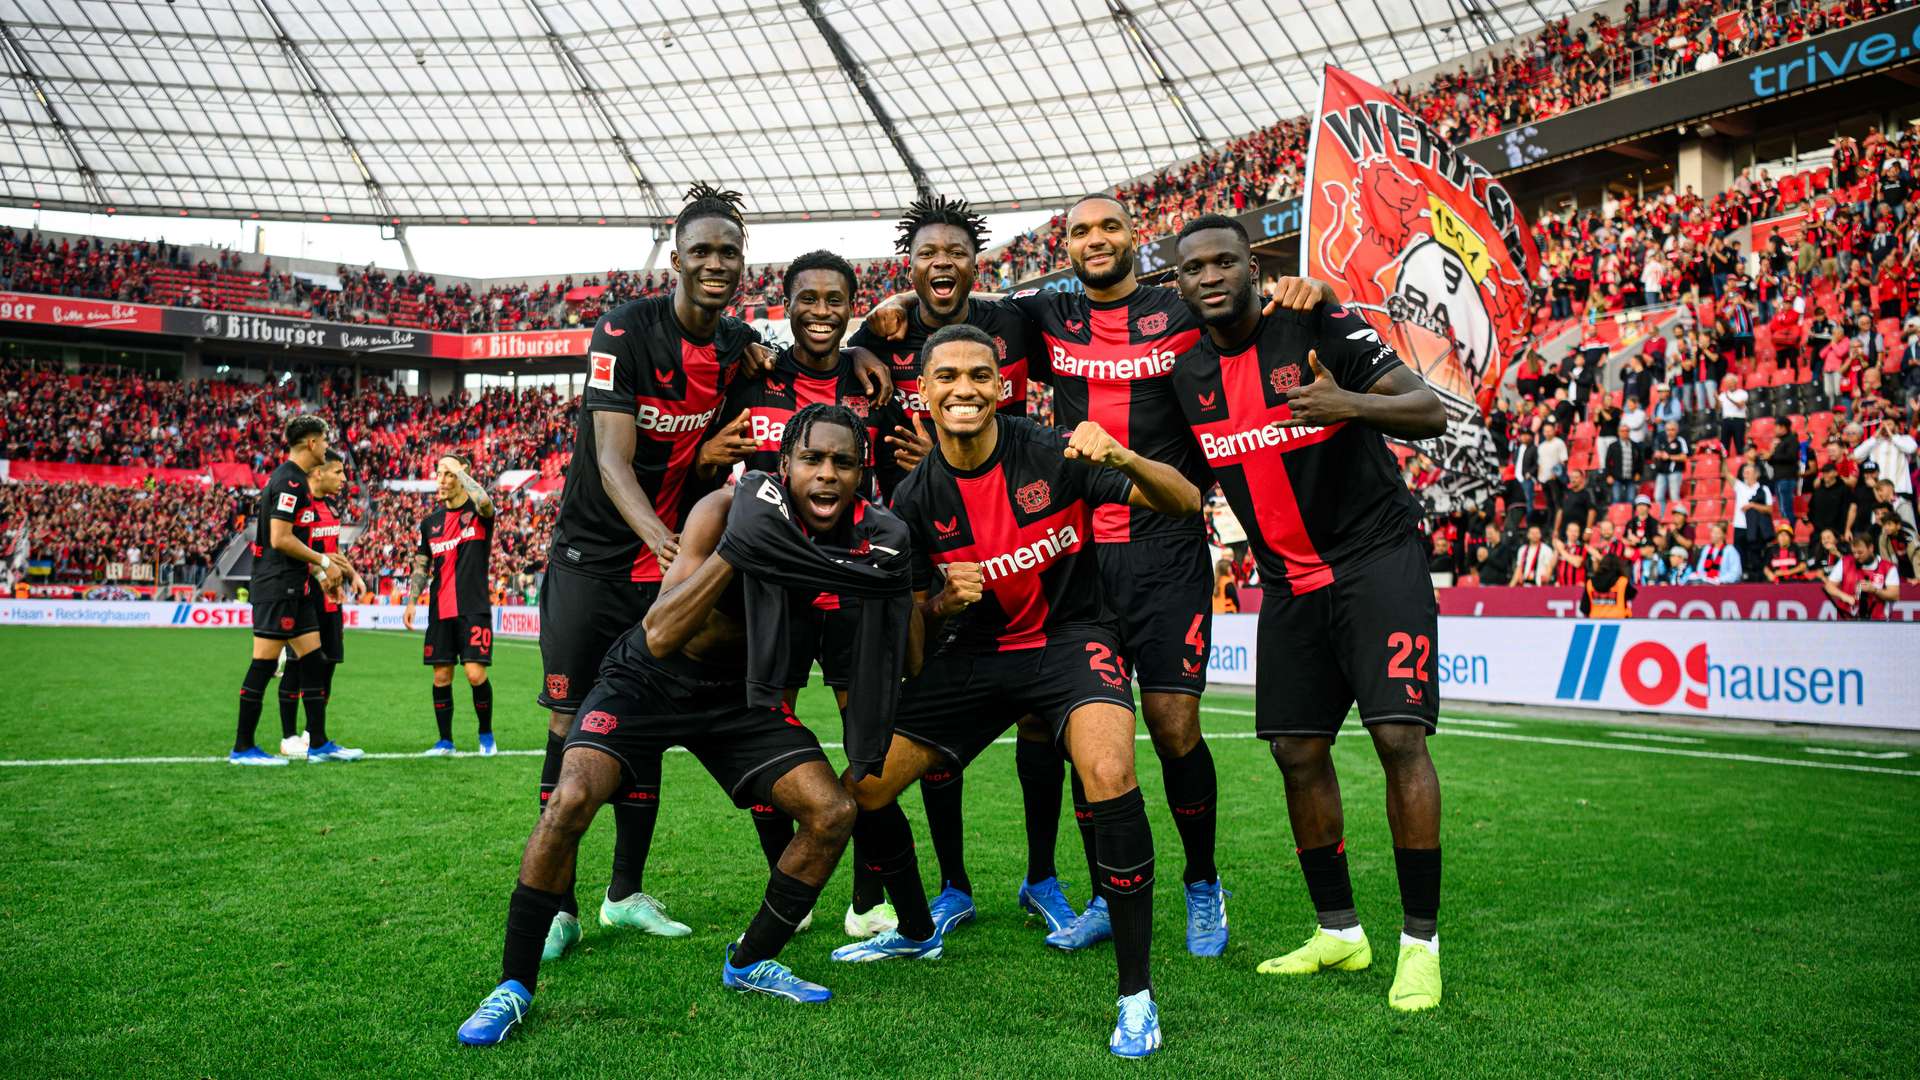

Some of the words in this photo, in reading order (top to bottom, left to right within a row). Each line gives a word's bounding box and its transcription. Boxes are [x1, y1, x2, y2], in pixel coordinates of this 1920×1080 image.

[1261, 201, 1305, 238] tri
[225, 315, 326, 347] Bitburger
[489, 335, 571, 357] Bitburger
[1053, 346, 1176, 380] Barmenia
[636, 404, 716, 433] Barme
[11, 607, 44, 621] Haan
[55, 607, 150, 624] Recklinghausen
[470, 625, 491, 647] 20
[1185, 613, 1205, 656] 4
[1388, 631, 1430, 682] 22
[1707, 654, 1864, 706] hausen
